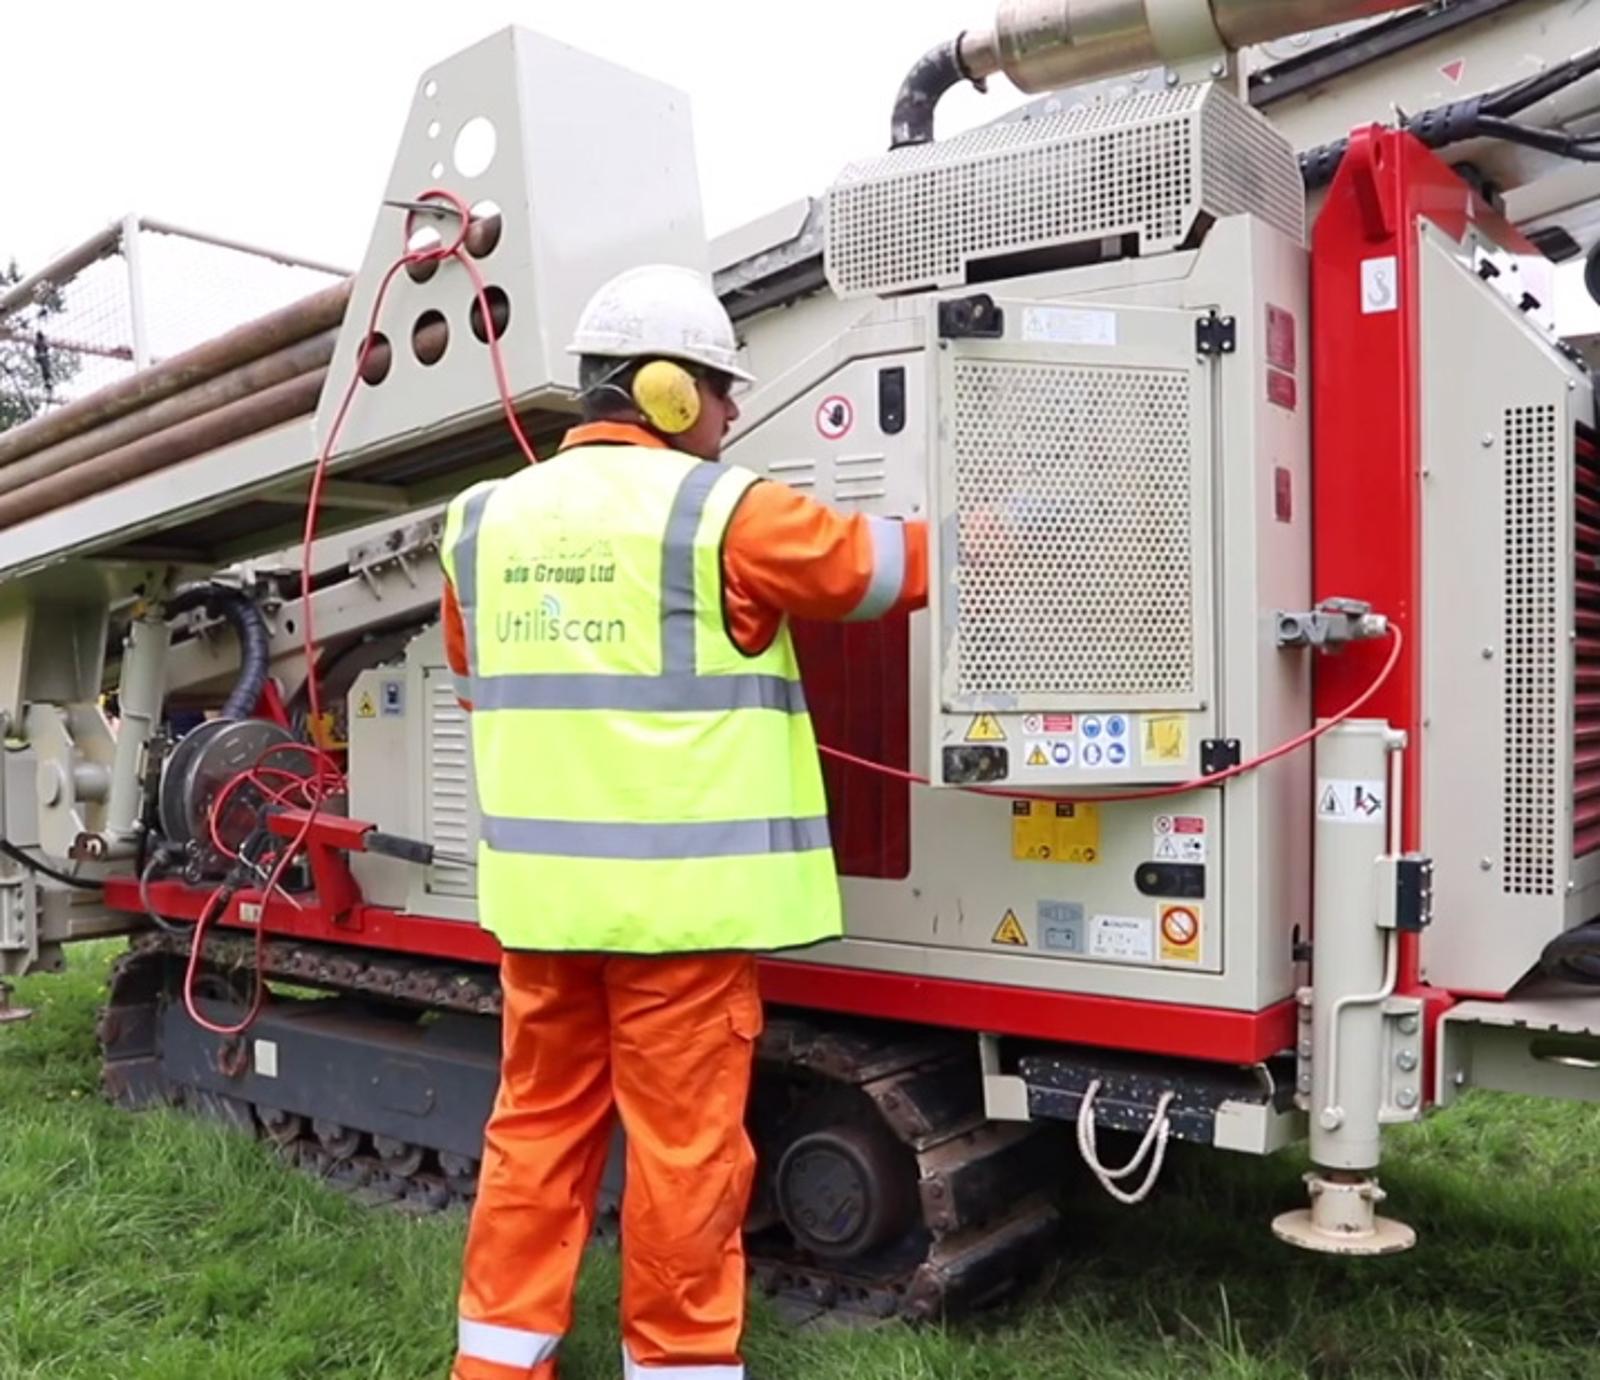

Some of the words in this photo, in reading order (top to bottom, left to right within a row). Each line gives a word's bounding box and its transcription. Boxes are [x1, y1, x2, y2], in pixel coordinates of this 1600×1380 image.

[534, 563, 585, 584] Group
[590, 563, 616, 582] Ltd
[496, 611, 625, 644] Utiliscan
